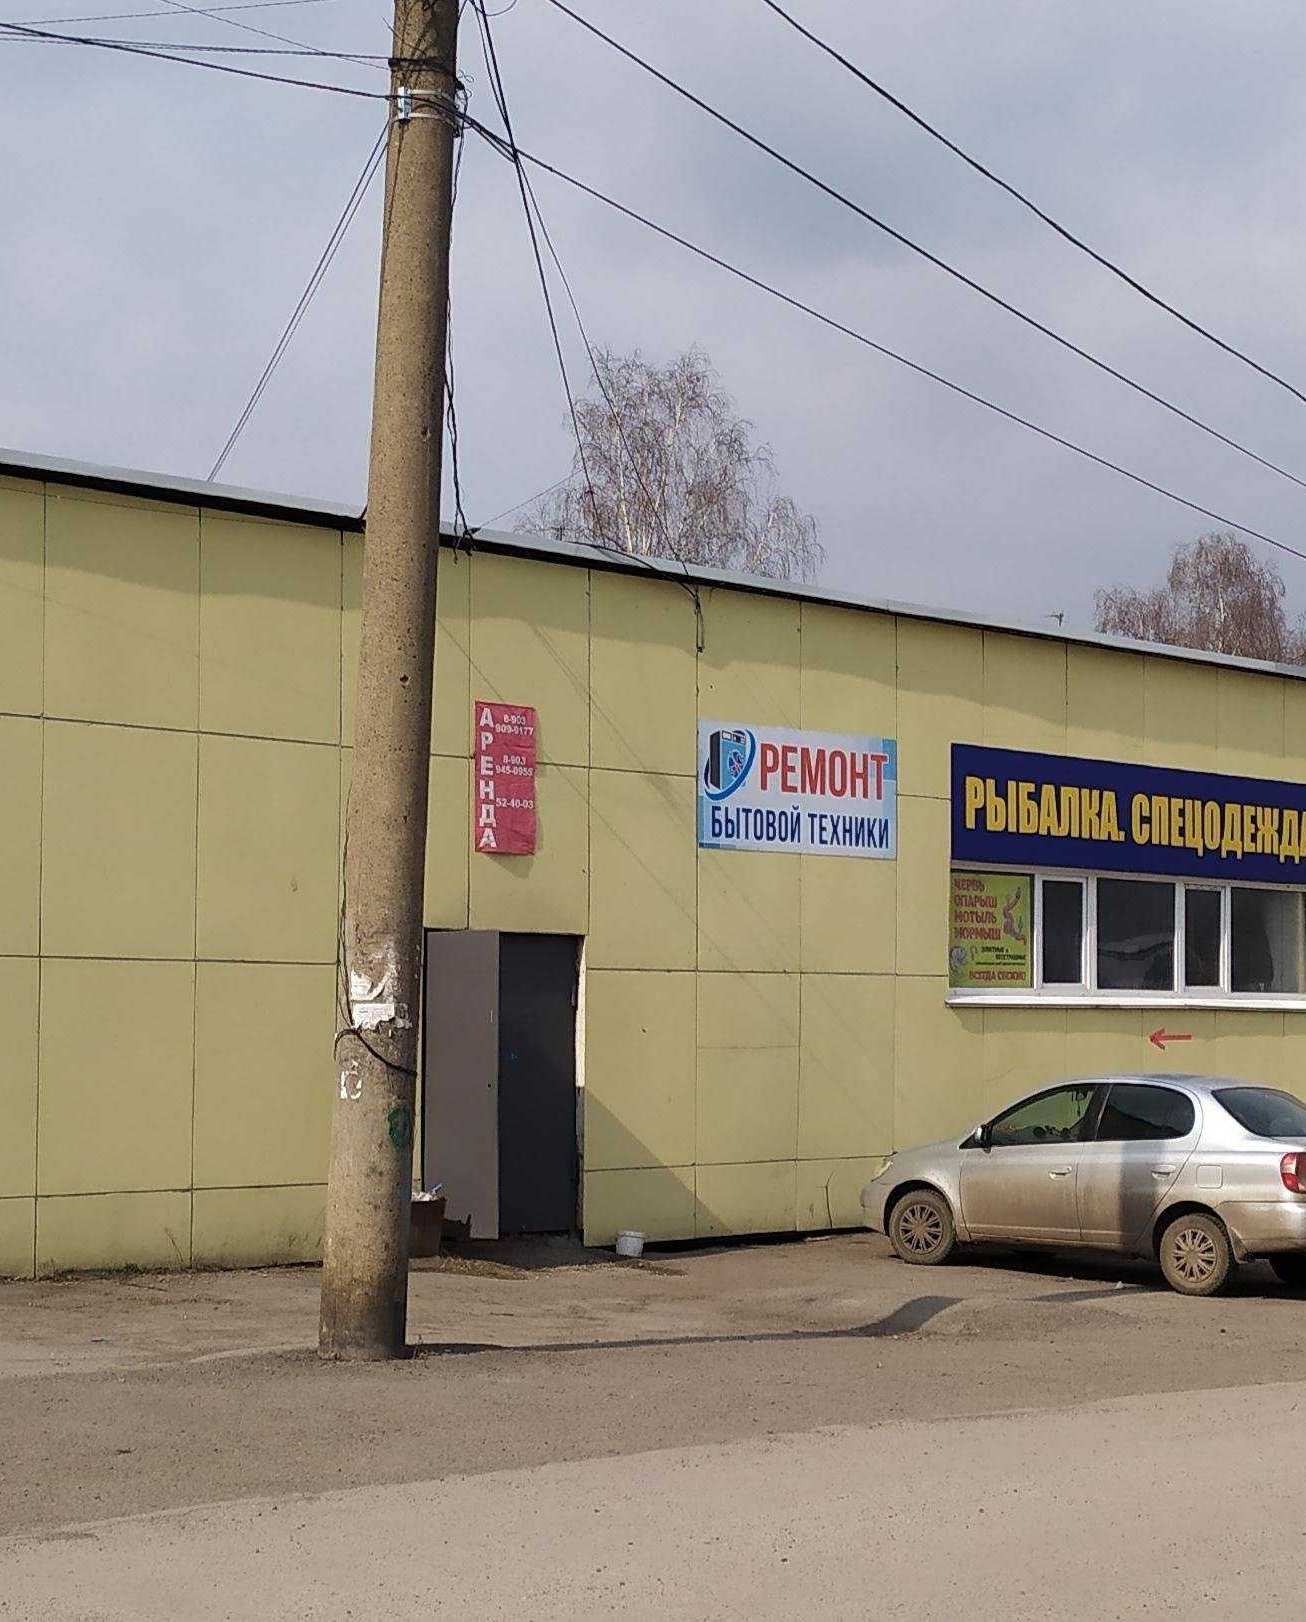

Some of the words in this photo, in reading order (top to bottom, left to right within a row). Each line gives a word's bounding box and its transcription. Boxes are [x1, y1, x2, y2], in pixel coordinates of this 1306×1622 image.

[479, 707, 497, 848] АРЕНДА
[760, 742, 889, 801] РЕМОНТ
[711, 804, 801, 844] БЫТОВОЙ
[807, 811, 890, 850] ТЕХНИКИ
[964, 776, 1126, 842] РЫБАЛКА.
[954, 895, 998, 909] ОПАРЫШ
[954, 910, 997, 924] МОТЫЛЬ
